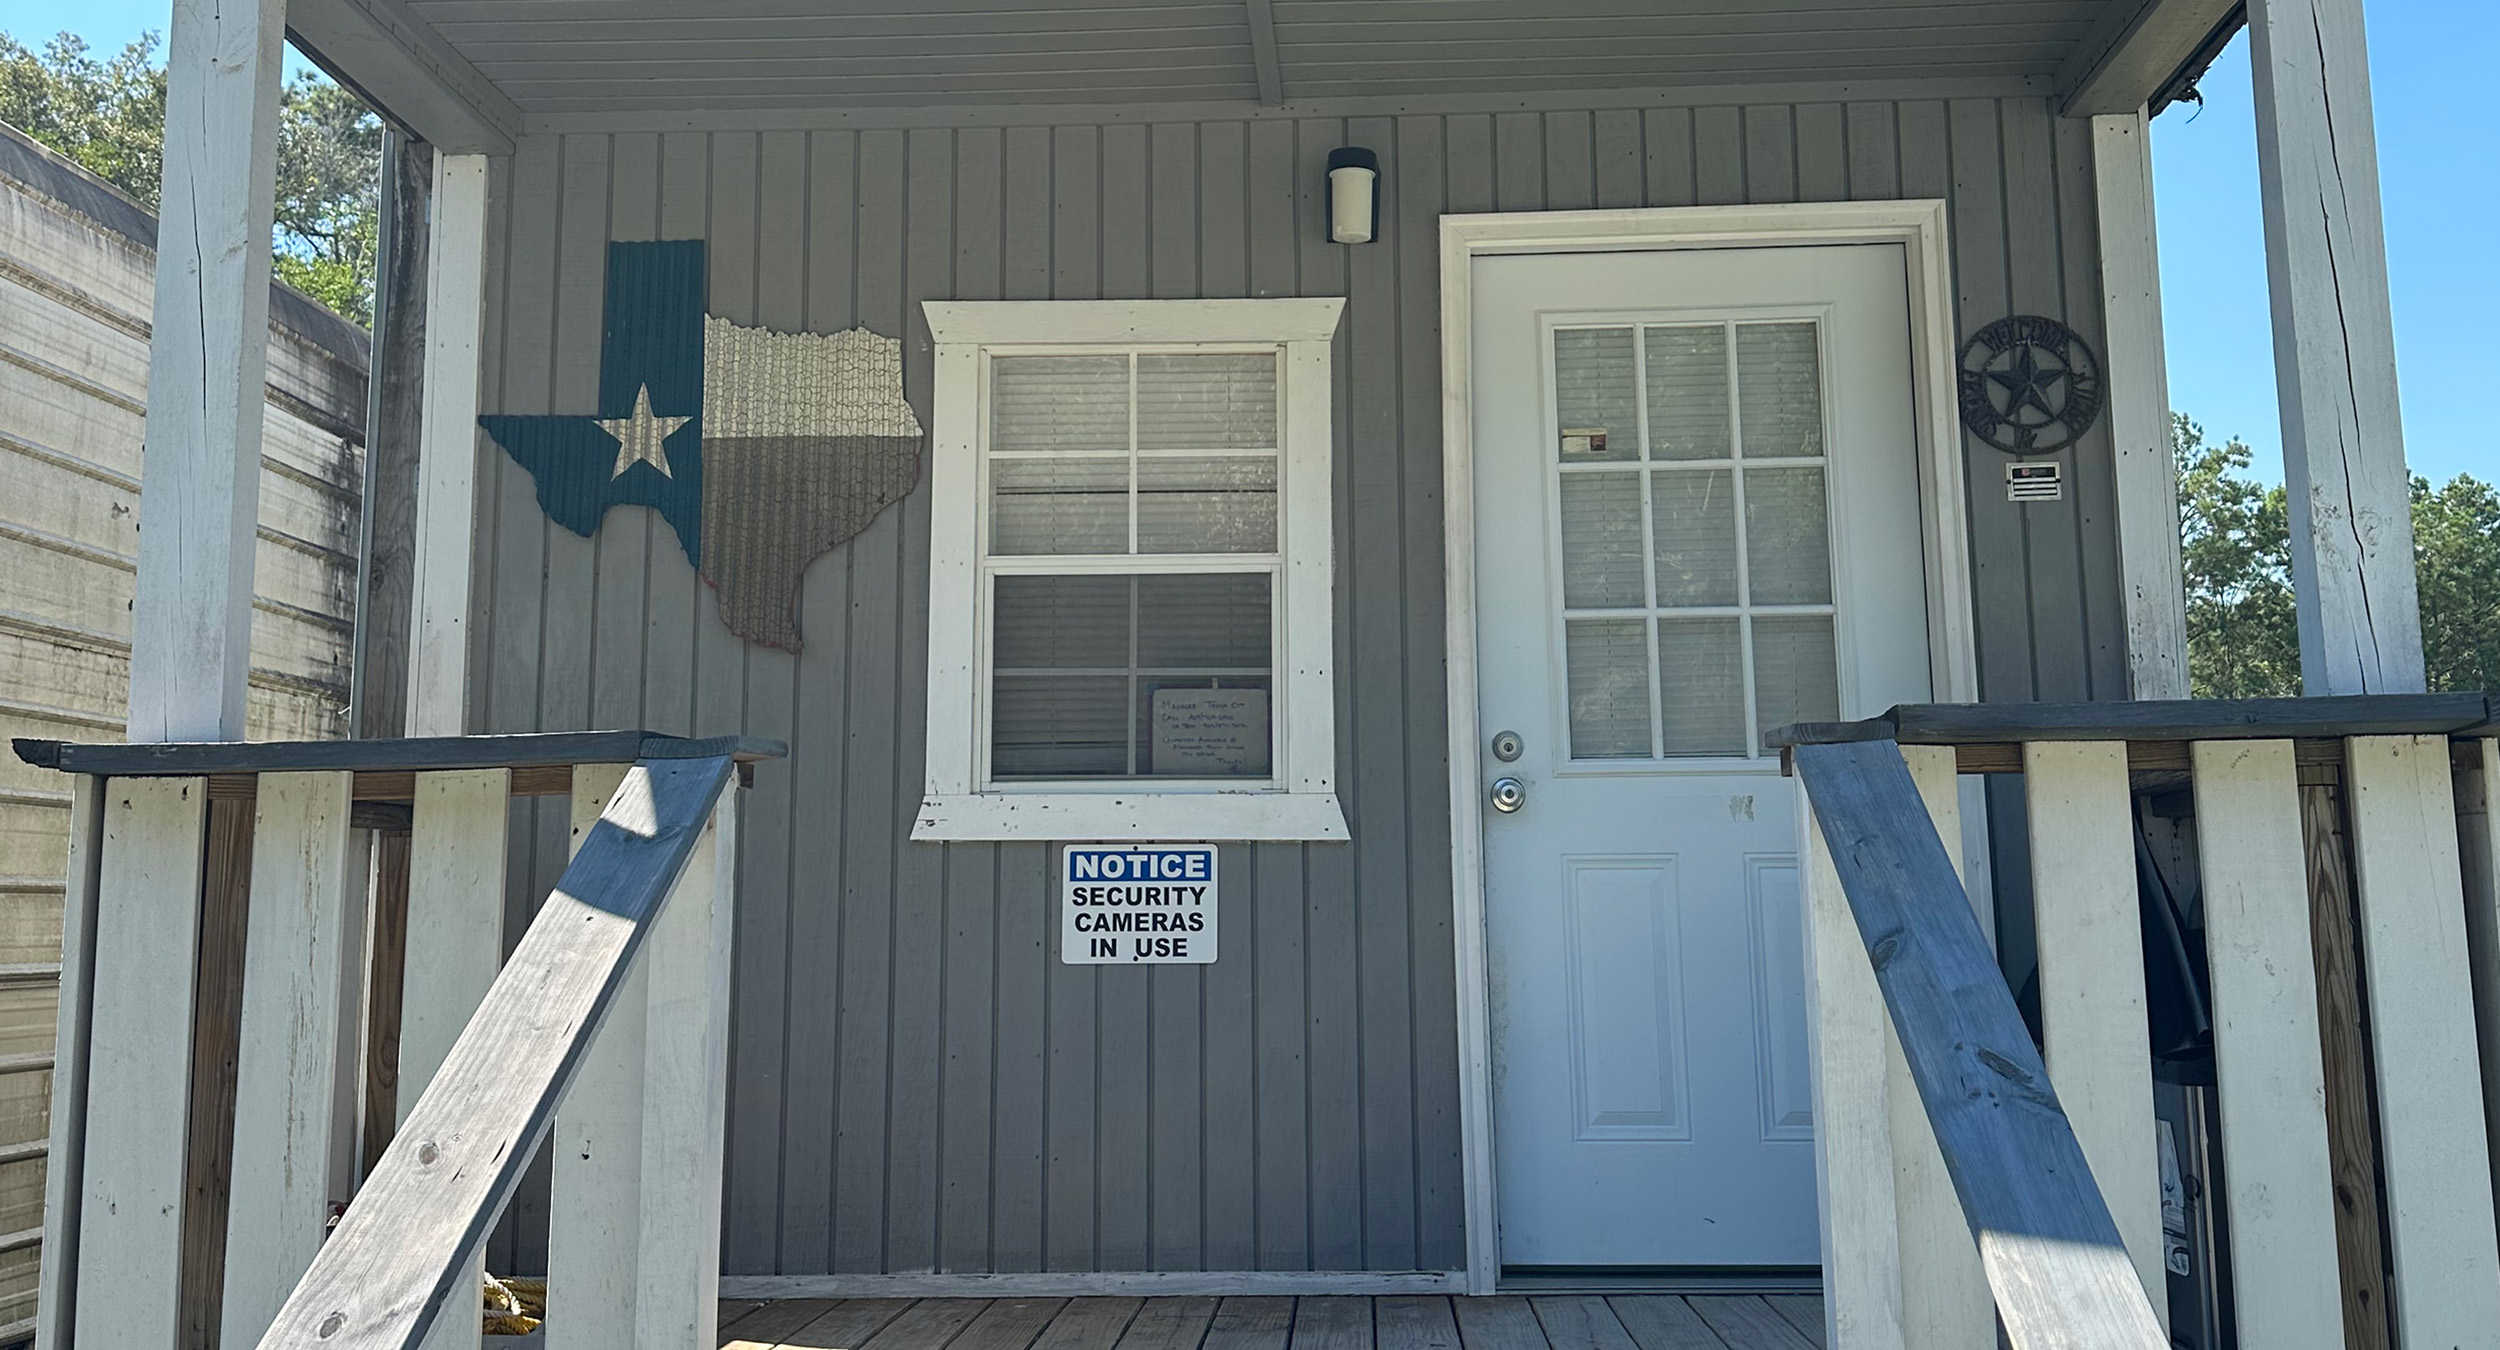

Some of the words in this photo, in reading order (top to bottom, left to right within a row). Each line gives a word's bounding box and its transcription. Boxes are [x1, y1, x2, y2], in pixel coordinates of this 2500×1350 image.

[1977, 318, 2066, 352] WELCOME
[1075, 854, 1205, 878] NOTICE
[1072, 886, 1206, 906] SECURITY
[1075, 912, 1204, 932] CAMERAS
[1090, 938, 1117, 957] IN
[1135, 938, 1187, 957] USE
